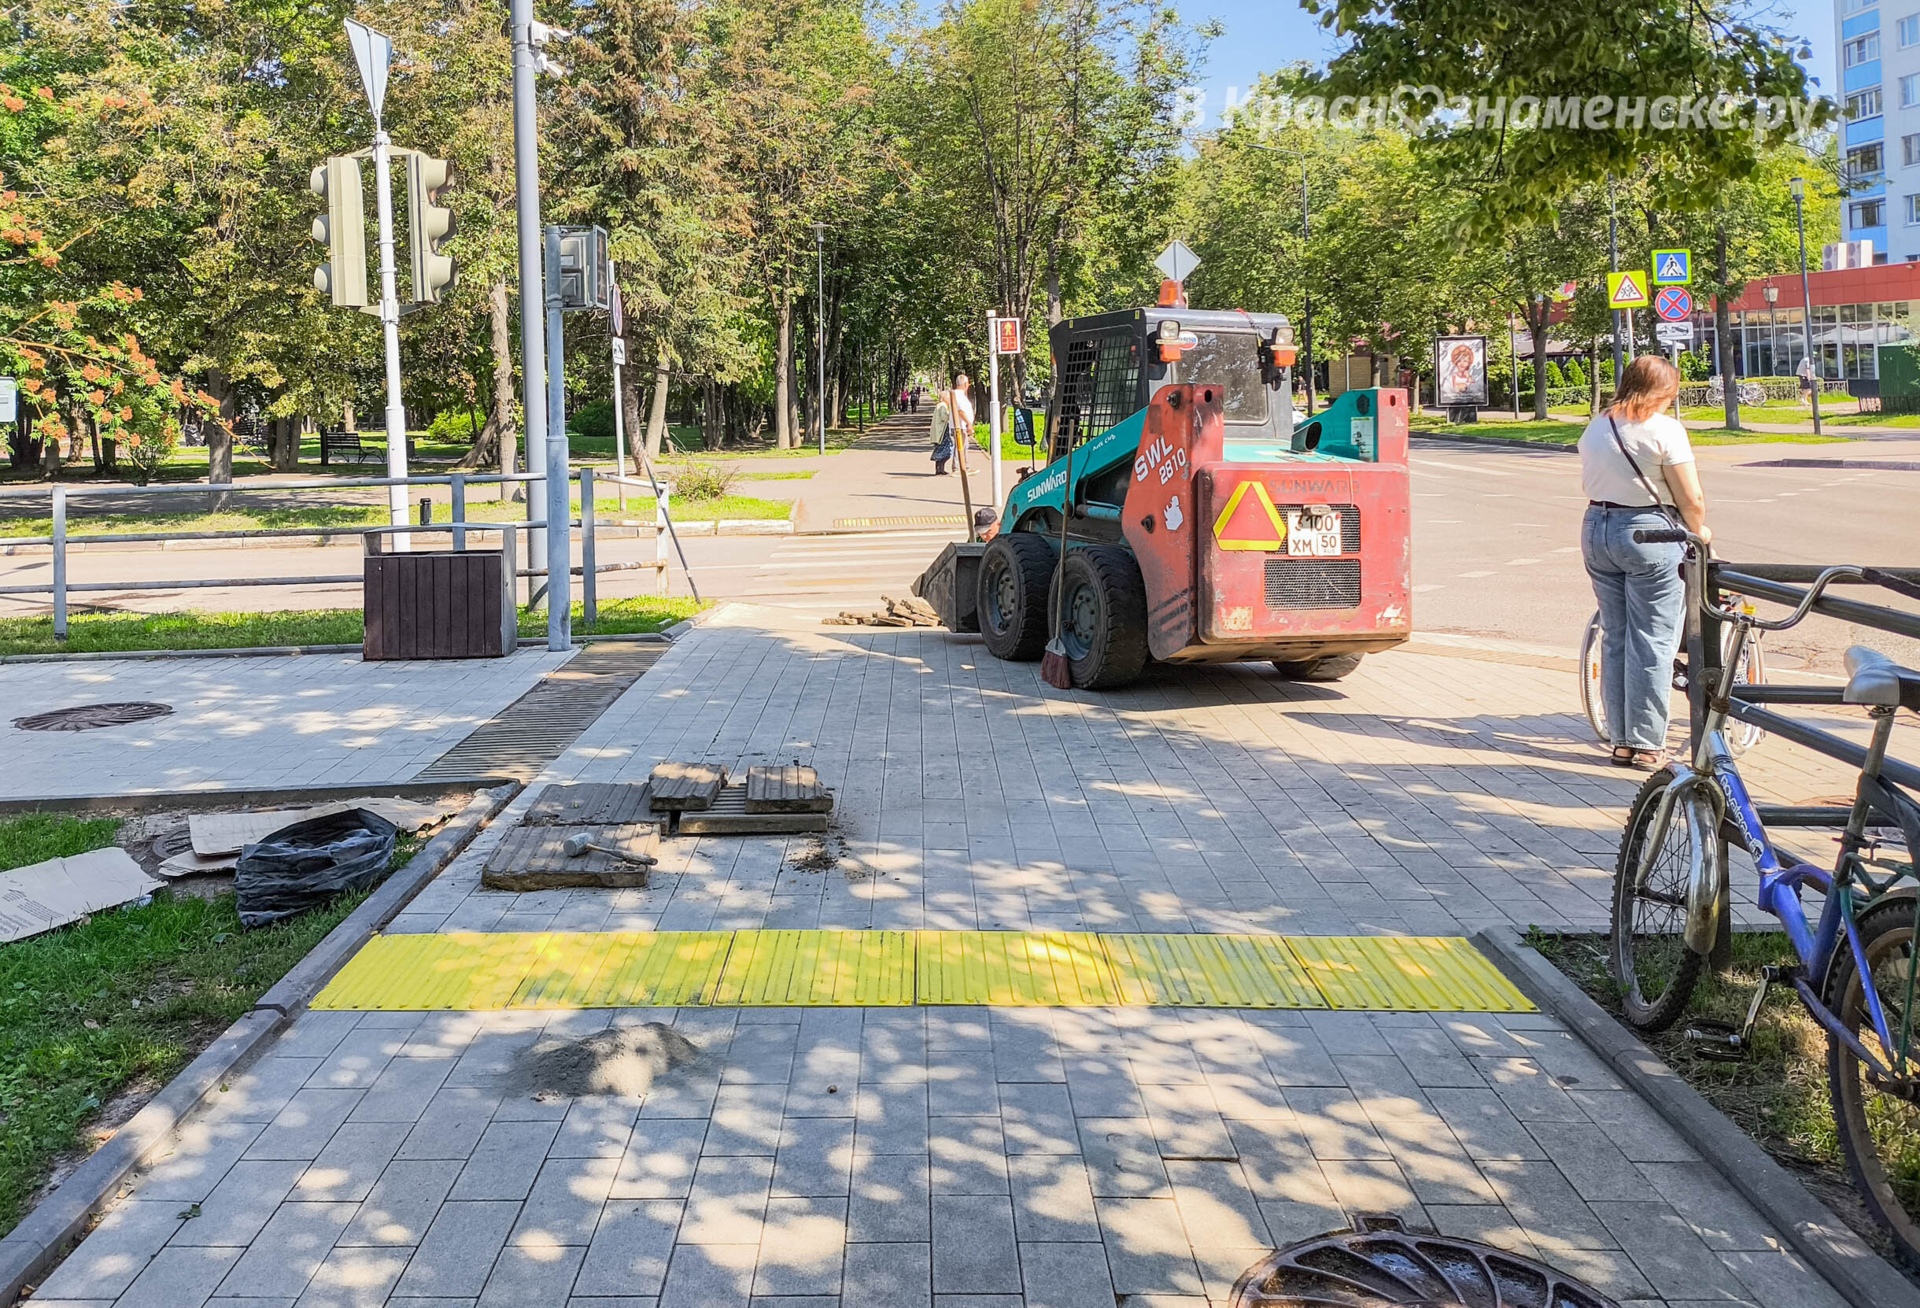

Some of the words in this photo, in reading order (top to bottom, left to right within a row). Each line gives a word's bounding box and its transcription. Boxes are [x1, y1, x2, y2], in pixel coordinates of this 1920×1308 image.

[1134, 434, 1173, 482] SWL
[1158, 447, 1186, 485] 2810
[1027, 469, 1068, 503] SUNWARD
[1268, 479, 1361, 495] SUNWARD
[1295, 514, 1334, 531] 3100
[1321, 535, 1337, 548] 50
